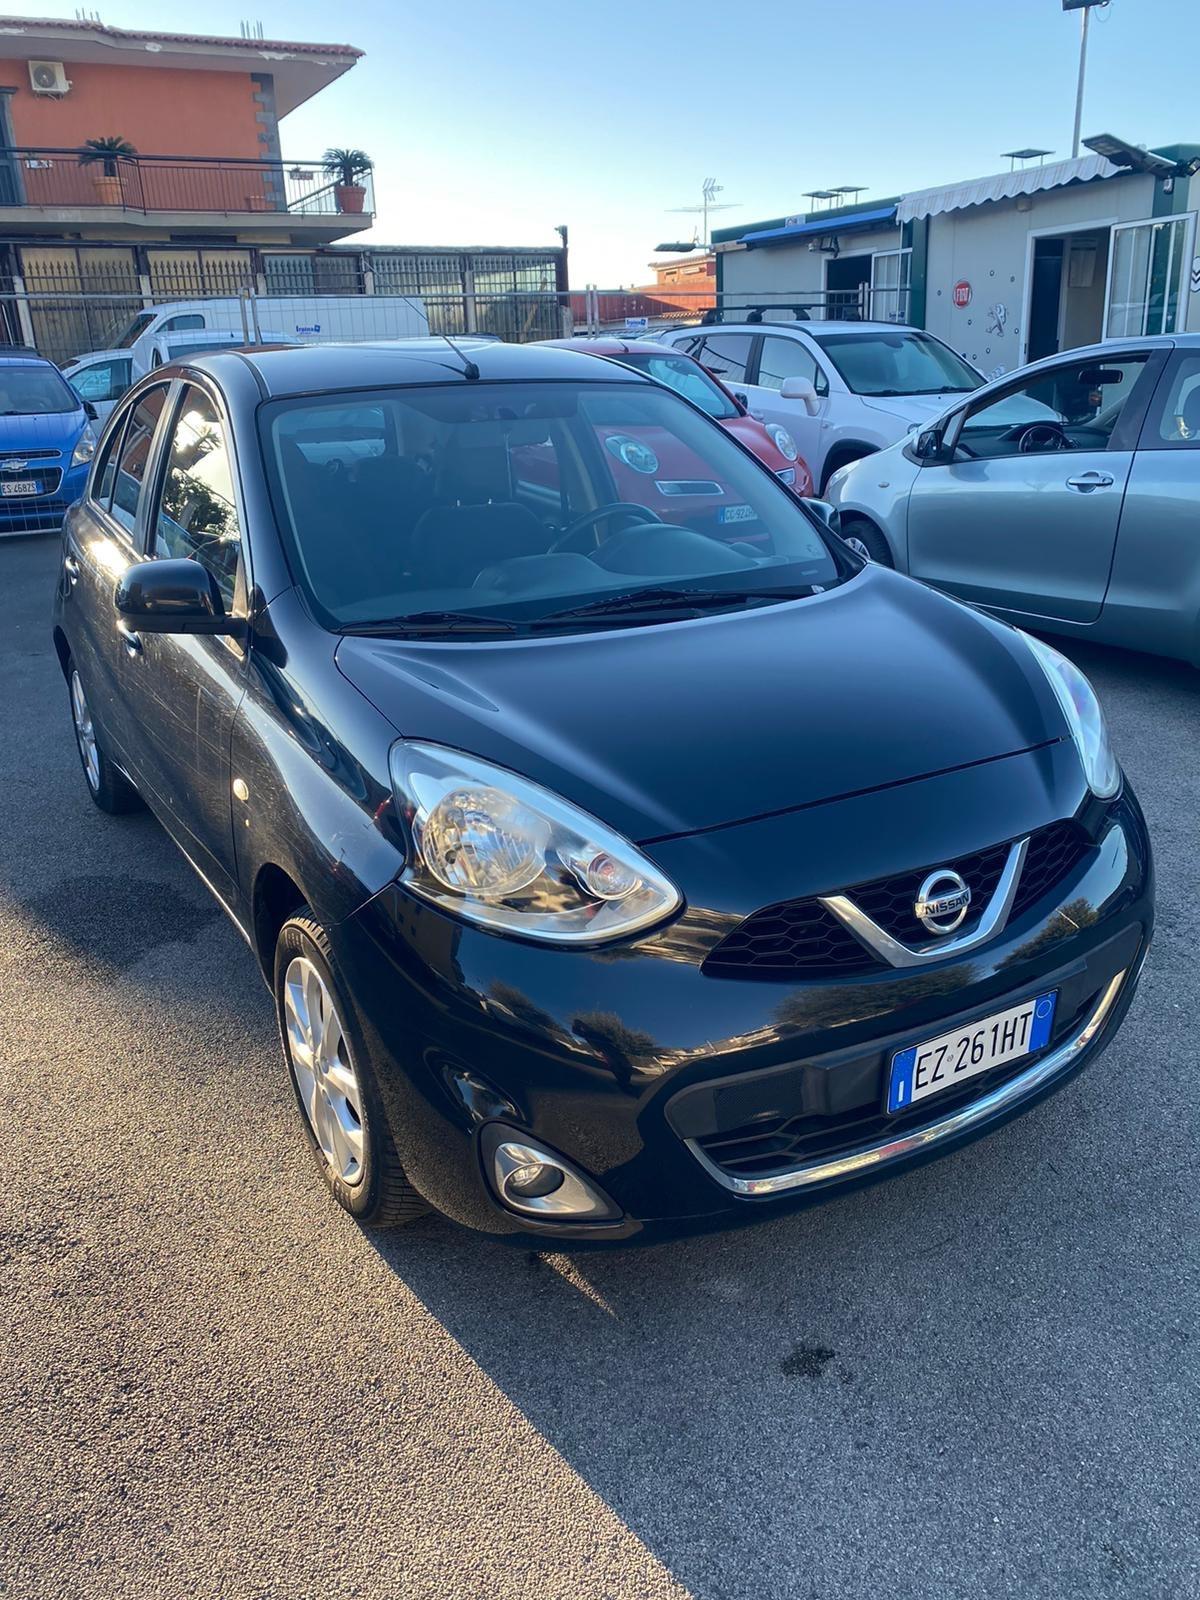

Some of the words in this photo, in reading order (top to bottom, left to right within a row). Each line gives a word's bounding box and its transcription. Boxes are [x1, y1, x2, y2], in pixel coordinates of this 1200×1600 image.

[925, 894, 969, 915] NISSAN
[915, 1044, 949, 1090] EZ
[954, 1011, 1033, 1073] 261HT
